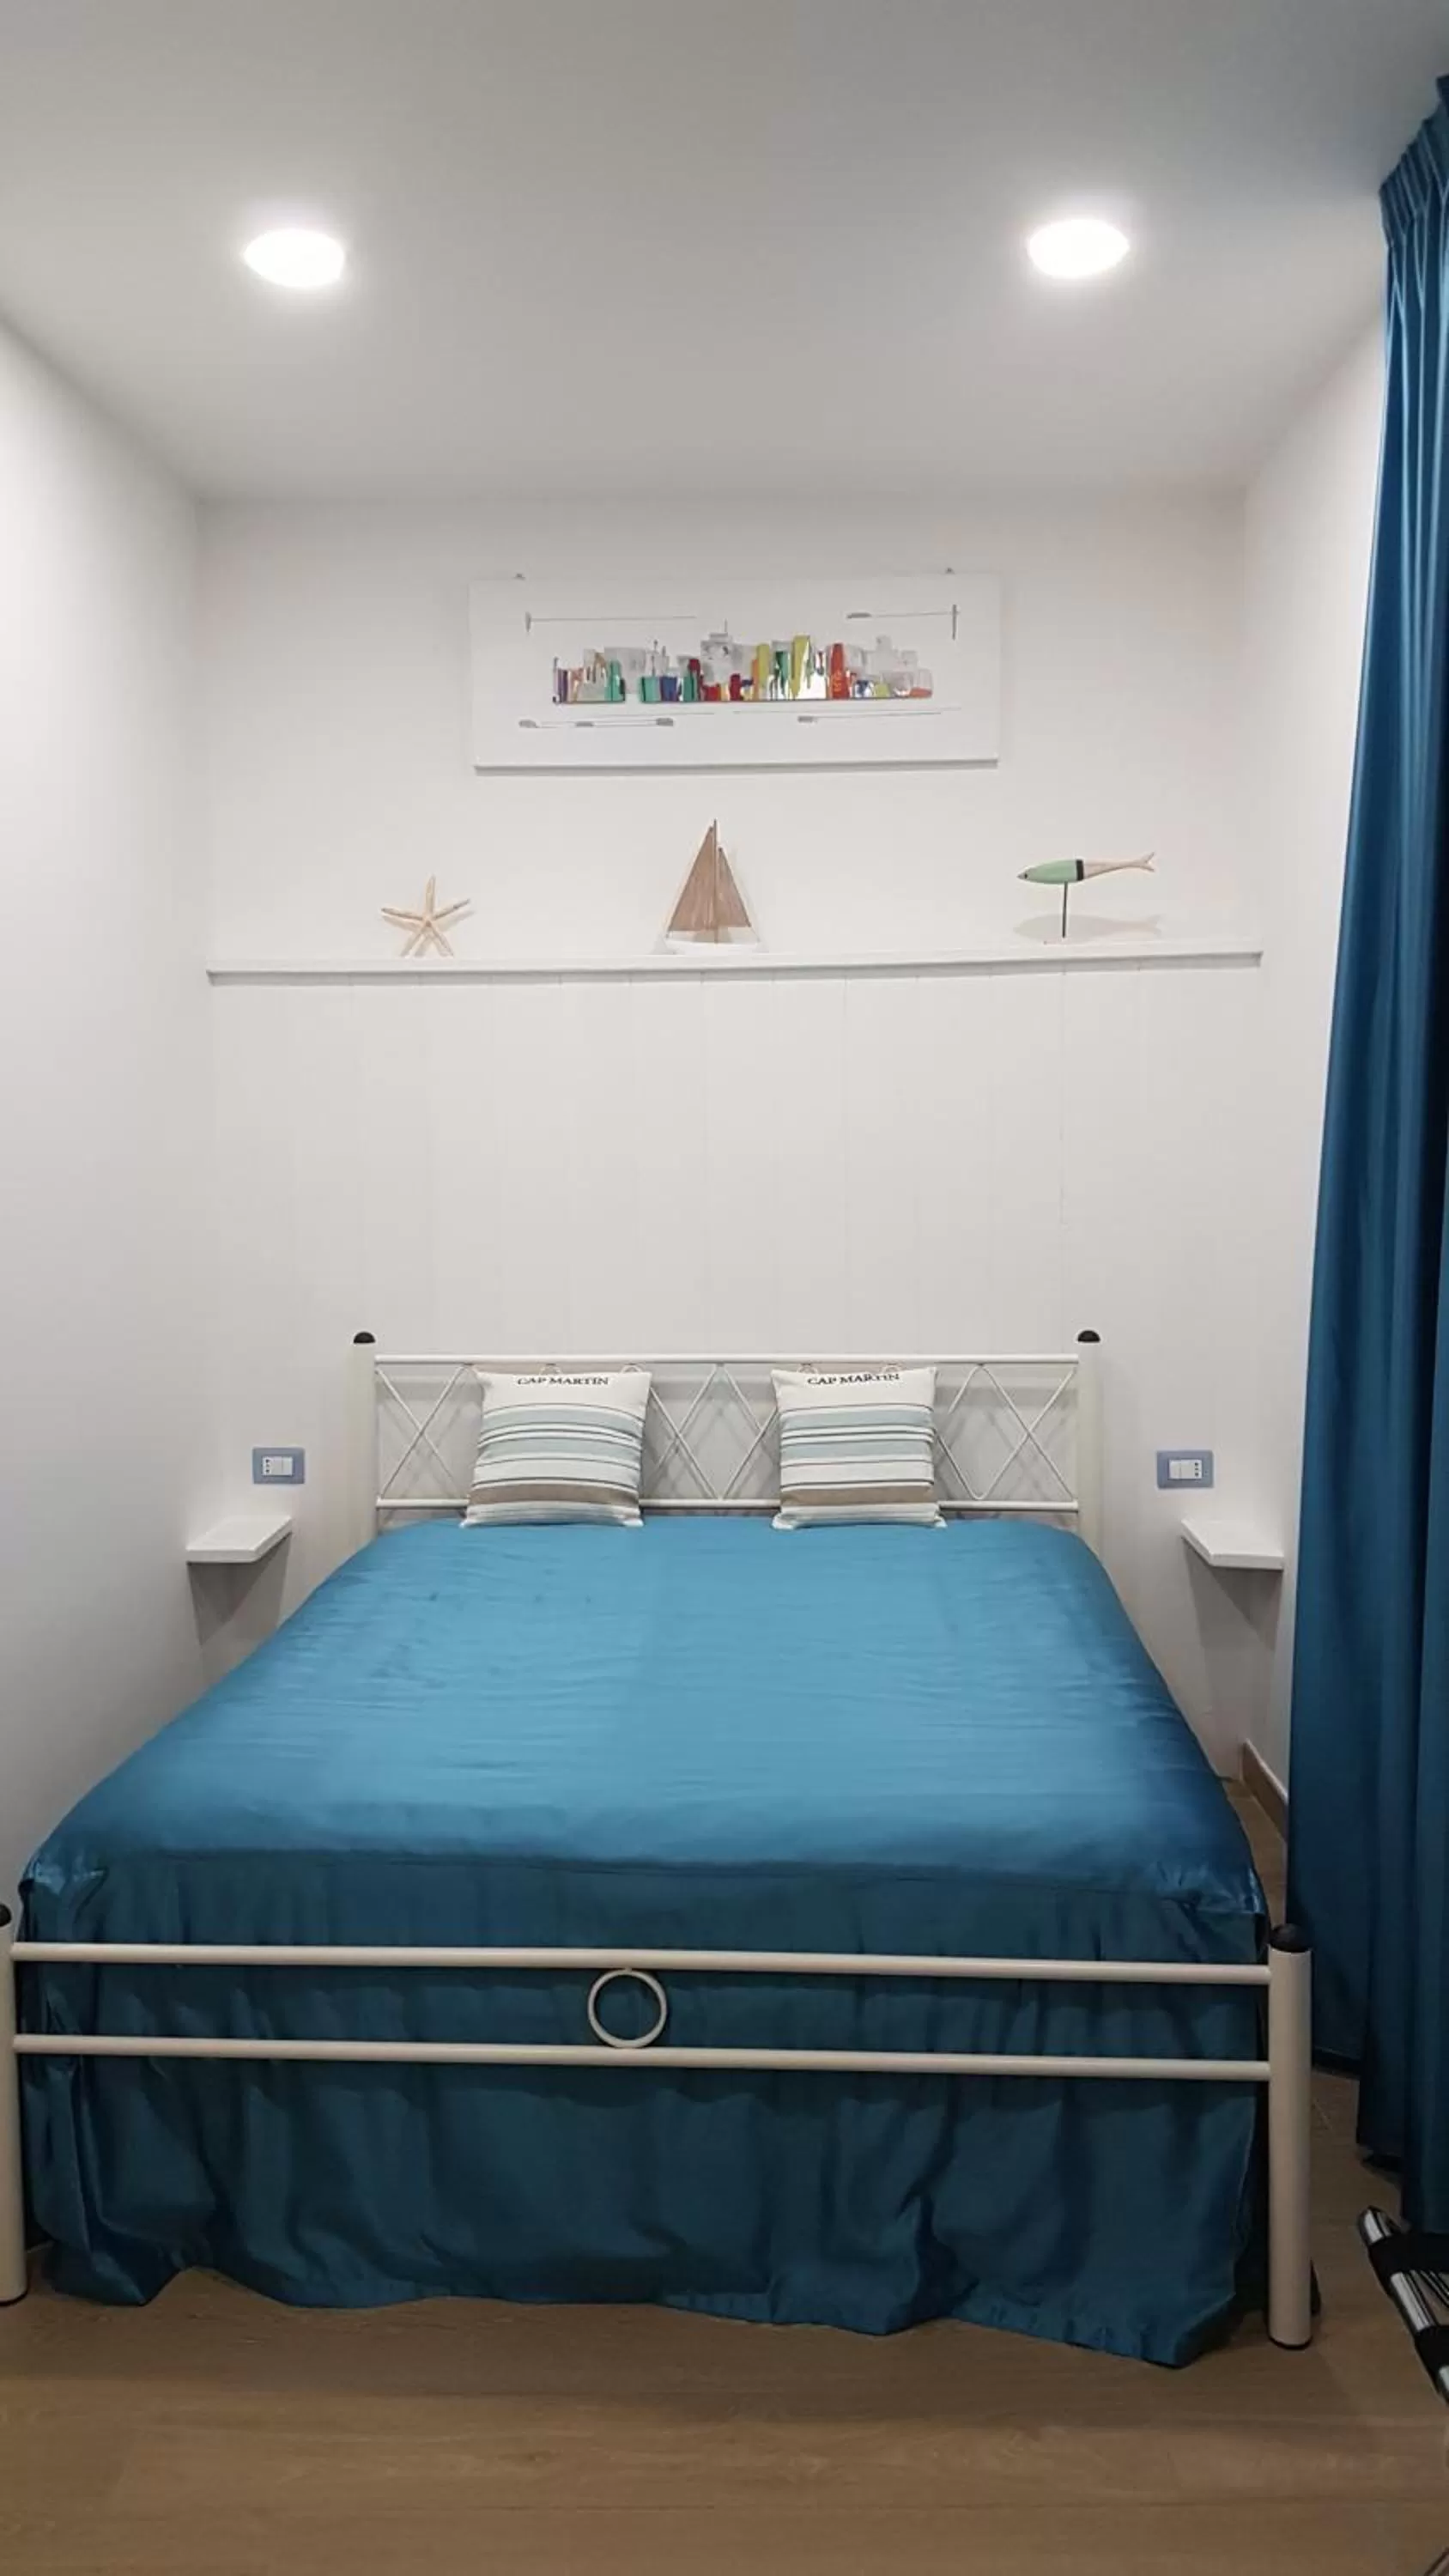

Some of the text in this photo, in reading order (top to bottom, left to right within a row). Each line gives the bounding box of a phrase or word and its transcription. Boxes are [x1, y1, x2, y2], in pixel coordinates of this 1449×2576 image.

[517, 1376, 609, 1385] CAP MARTIN
[807, 1373, 900, 1385] CAP MARTIN
